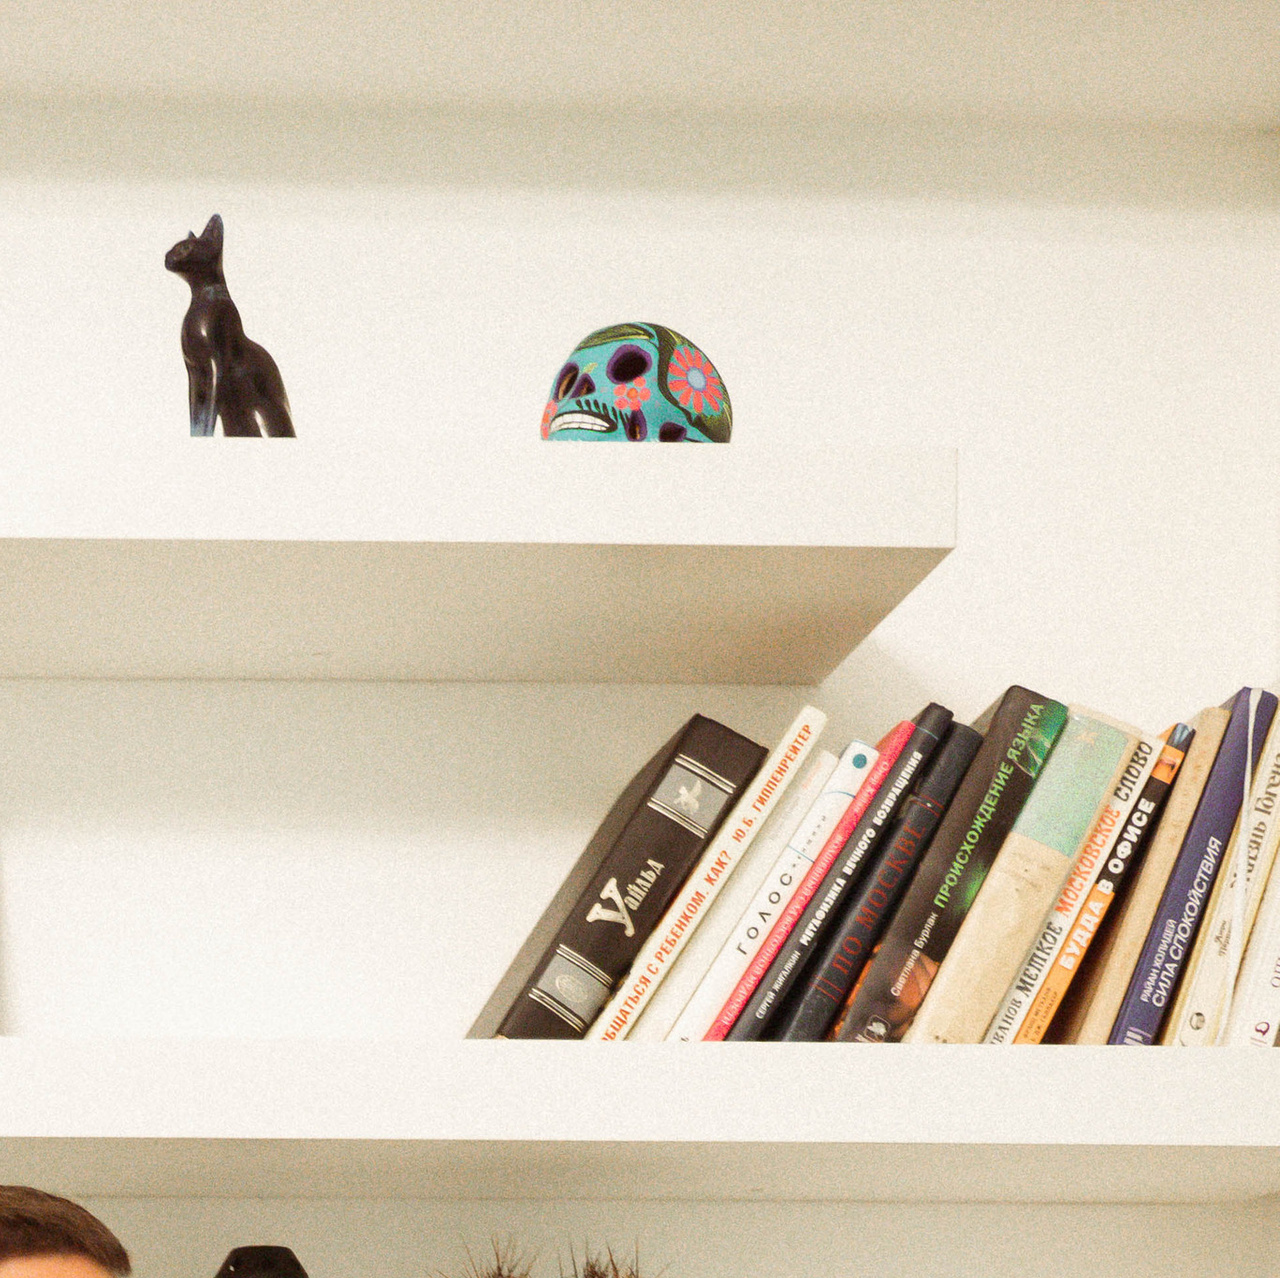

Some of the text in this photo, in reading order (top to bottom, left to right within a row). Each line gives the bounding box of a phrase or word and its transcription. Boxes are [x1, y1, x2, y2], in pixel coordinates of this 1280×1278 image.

[585, 858, 663, 937] Уайльд
[600, 973, 652, 1043] БЩАТЬСЯ
[644, 961, 661, 976] С
[653, 889, 707, 964] РЕБЕНКОМ.
[702, 848, 730, 887] КАК?
[750, 723, 812, 813] ГИППЕНРЕЙТЕР
[734, 871, 795, 957] ГОЛОС
[753, 989, 777, 1020] СЕРГЕЙ
[799, 876, 846, 947] МЕТАФИЗИКА
[841, 826, 877, 876] ВЕЧНОГО
[871, 749, 923, 827] ВОЗВРАЩЕНИЯ
[831, 818, 923, 975] ПО МОСКВЕ
[889, 702, 1045, 997] Светлана Бурлак ПРОИСХОЖДЕНИЕ ЯЗЫКА
[988, 739, 1150, 1049] ВАНОВ МЕТКОЕ МОСКОВСКОЕ СЛОВО
[1058, 797, 1156, 970] БУДДА В ОФИСЕ
[1149, 835, 1222, 1008] СИЛА СПОКОЙСТВИЯ
